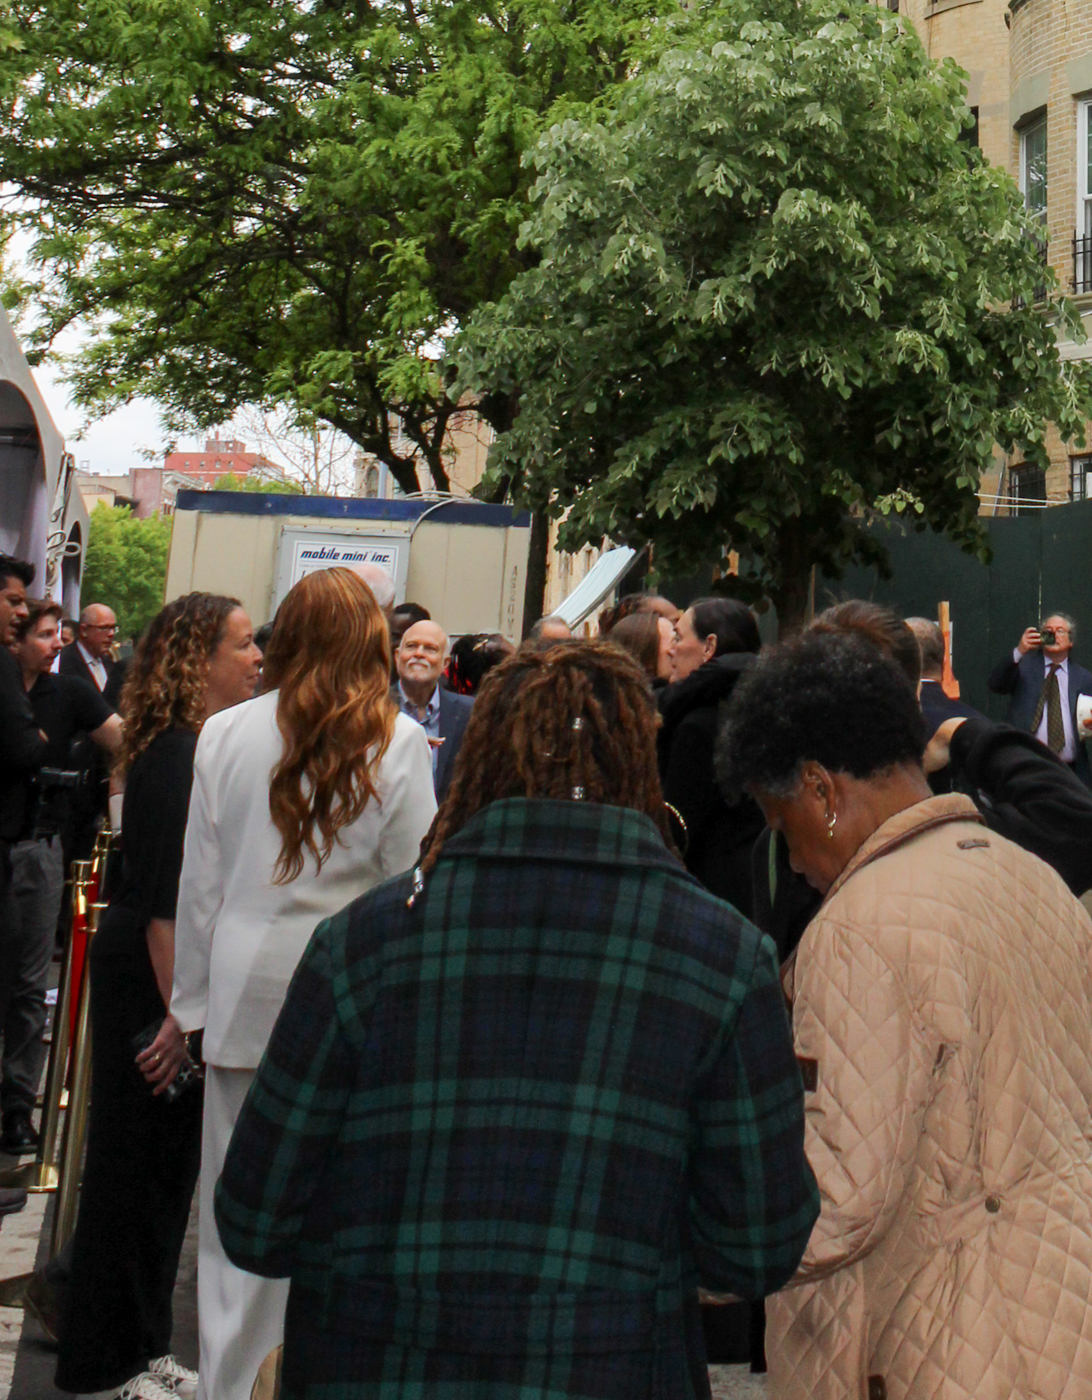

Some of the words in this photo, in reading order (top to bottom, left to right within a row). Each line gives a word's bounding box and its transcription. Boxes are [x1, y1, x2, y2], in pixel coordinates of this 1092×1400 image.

[300, 546, 340, 560] mobile
[341, 550, 367, 562] mini
[371, 552, 391, 563] inc.
